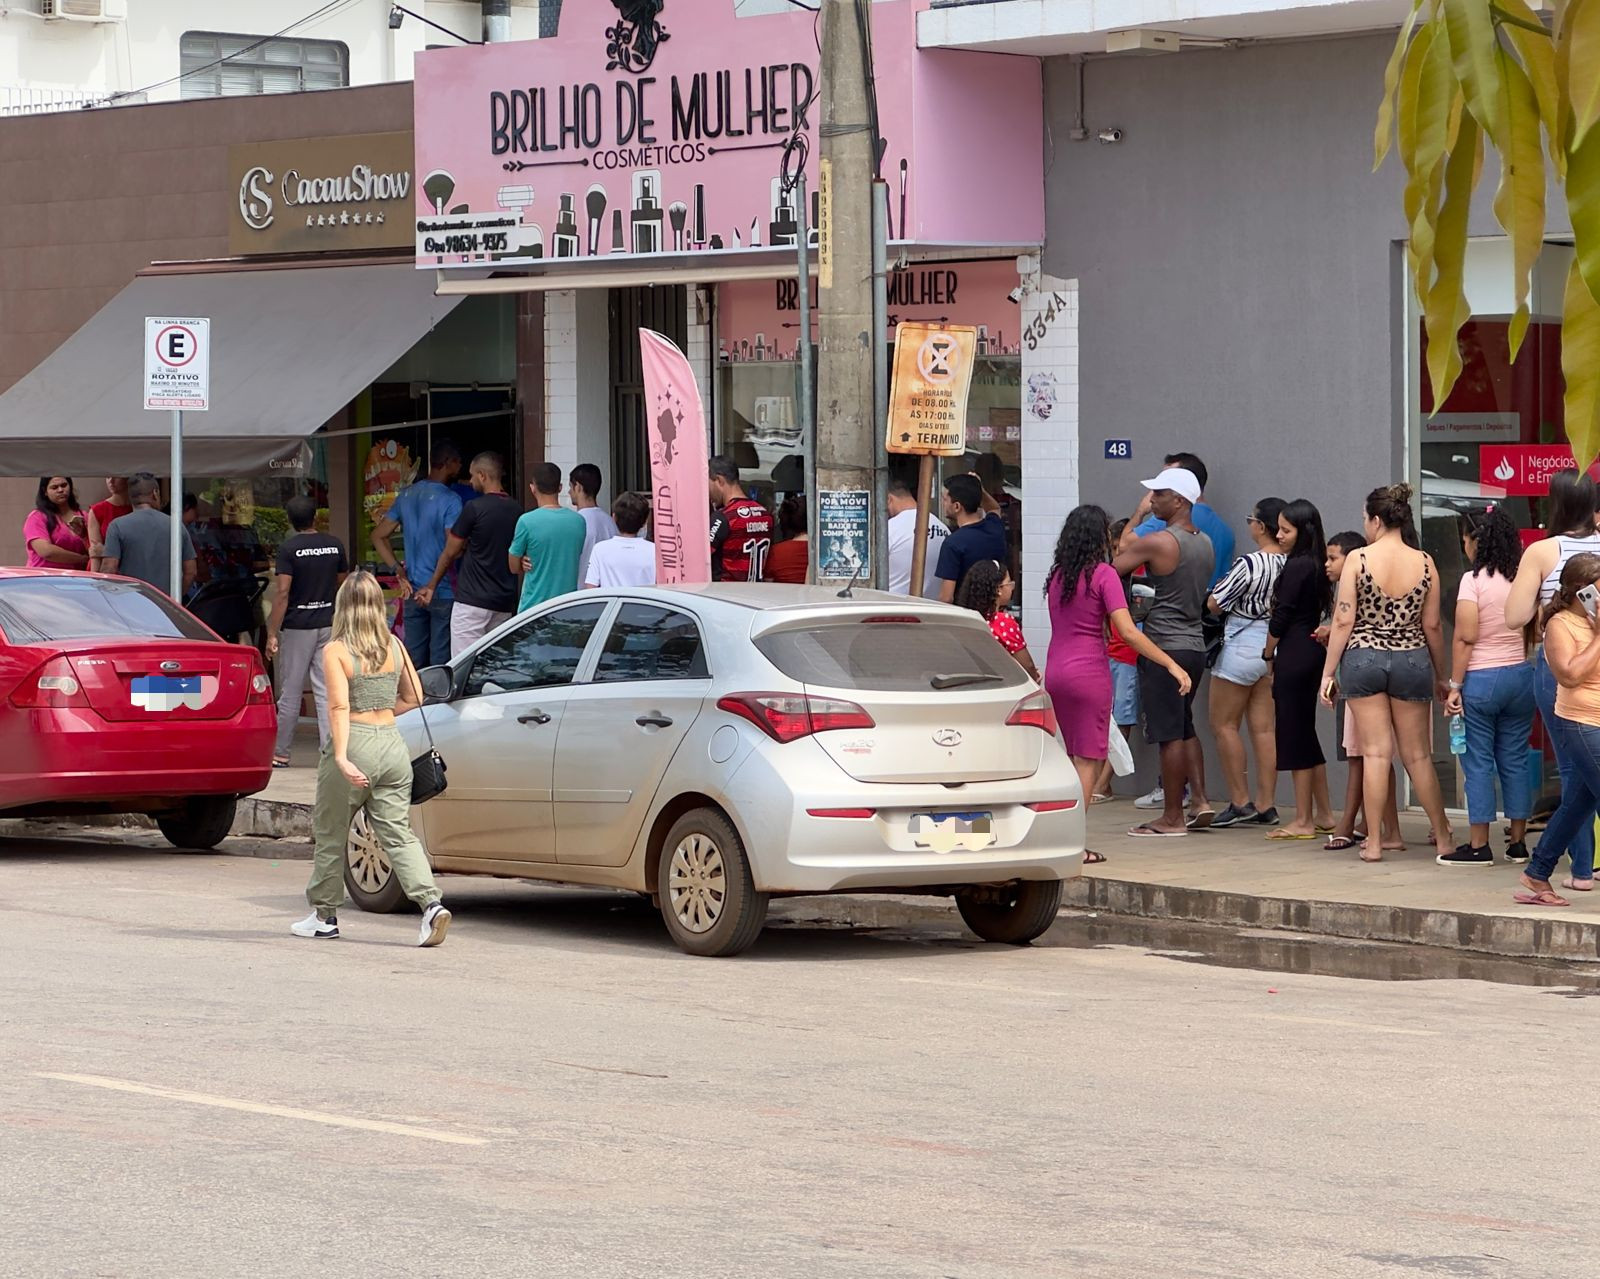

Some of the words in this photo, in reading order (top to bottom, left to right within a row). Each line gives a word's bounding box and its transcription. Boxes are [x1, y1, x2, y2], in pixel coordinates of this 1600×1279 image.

[491, 83, 601, 155] BRILHO
[616, 77, 657, 147] DE
[671, 63, 813, 142] MULHER
[593, 142, 706, 171] COSMÉTICOS
[281, 164, 411, 206] CacauShow
[887, 270, 957, 306] MULHER
[1023, 291, 1066, 351] 334A
[169, 334, 184, 358] E
[911, 398, 923, 406] DE
[910, 410, 921, 418] AS
[917, 433, 959, 444] TERMINO
[1109, 443, 1127, 456] 48
[1528, 455, 1575, 471] Negócios
[1528, 473, 1535, 483] e
